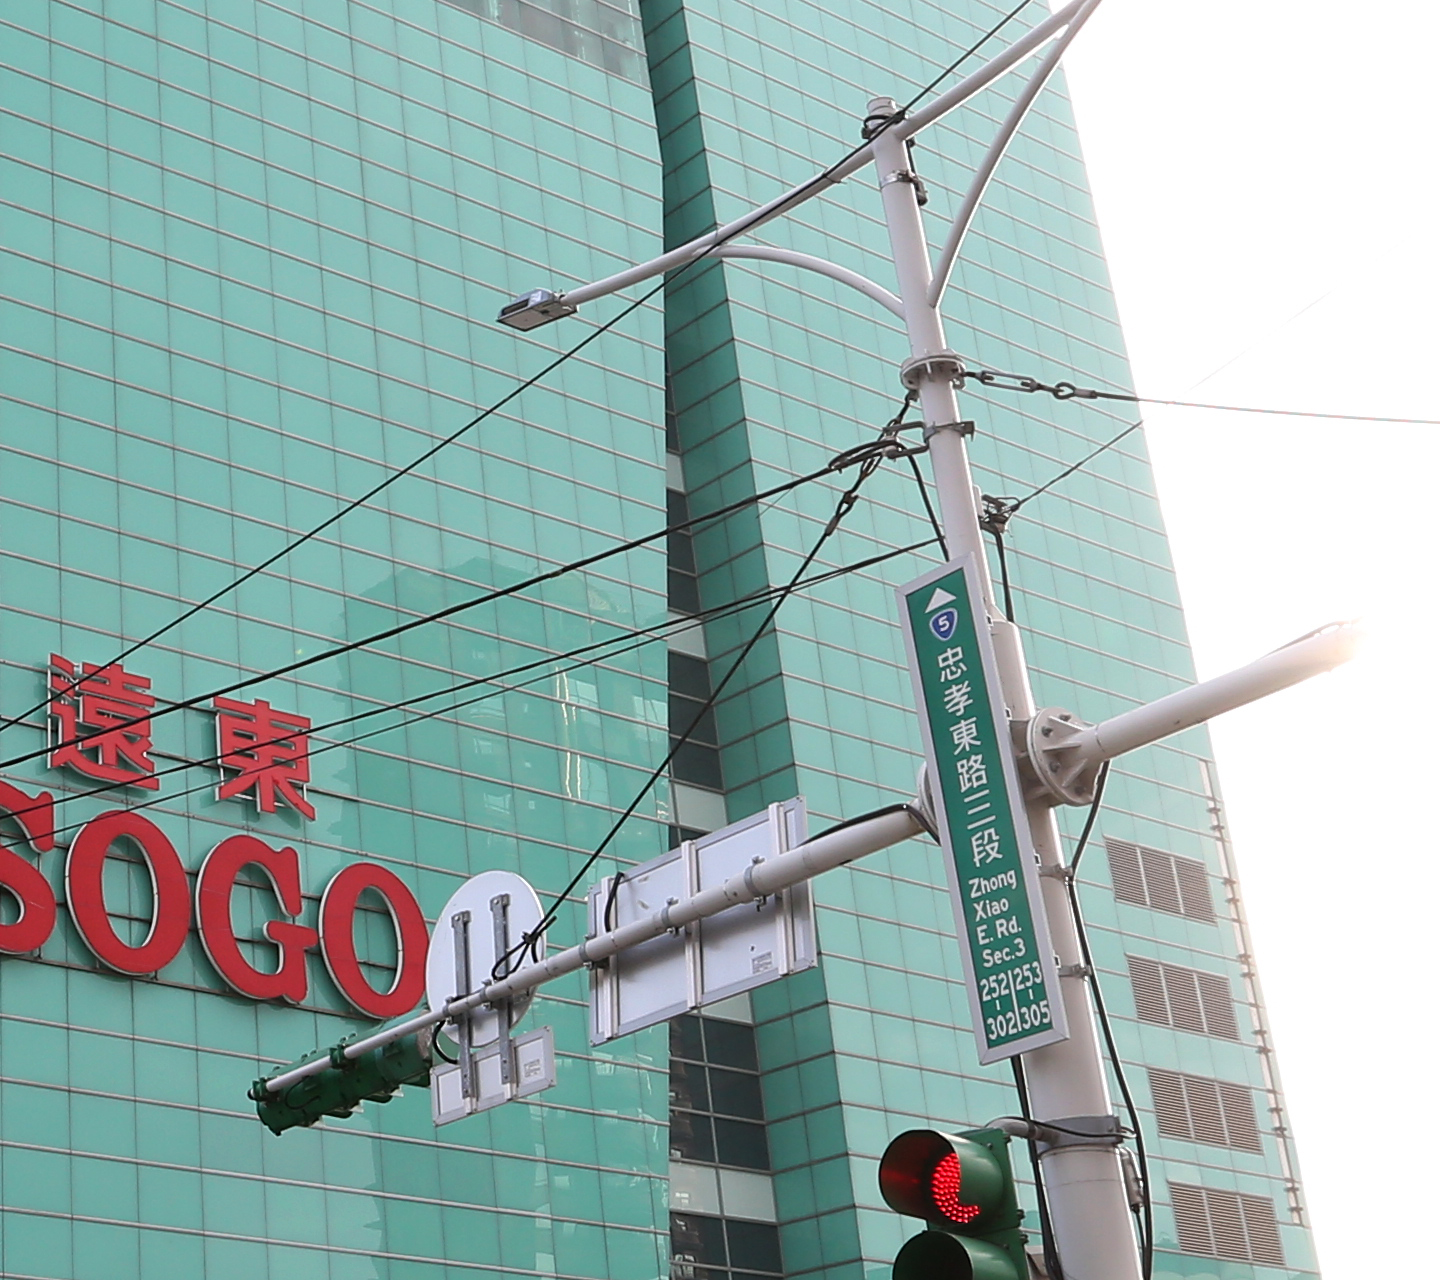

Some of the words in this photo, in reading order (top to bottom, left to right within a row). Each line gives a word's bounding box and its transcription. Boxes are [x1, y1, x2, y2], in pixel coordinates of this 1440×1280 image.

[938, 615, 951, 632] 5
[47, 651, 316, 821] 遠東
[936, 645, 1003, 867] 忠孝東路三段
[968, 869, 1017, 899] Zhong
[973, 897, 1010, 922] Xiao
[976, 924, 994, 945] E.
[995, 915, 1022, 939] Rd.
[982, 937, 1026, 968] Sec.3
[979, 972, 1010, 1002] 252
[1013, 961, 1043, 992] 253
[986, 1011, 1019, 1040] 302
[1020, 1000, 1051, 1030] 305
